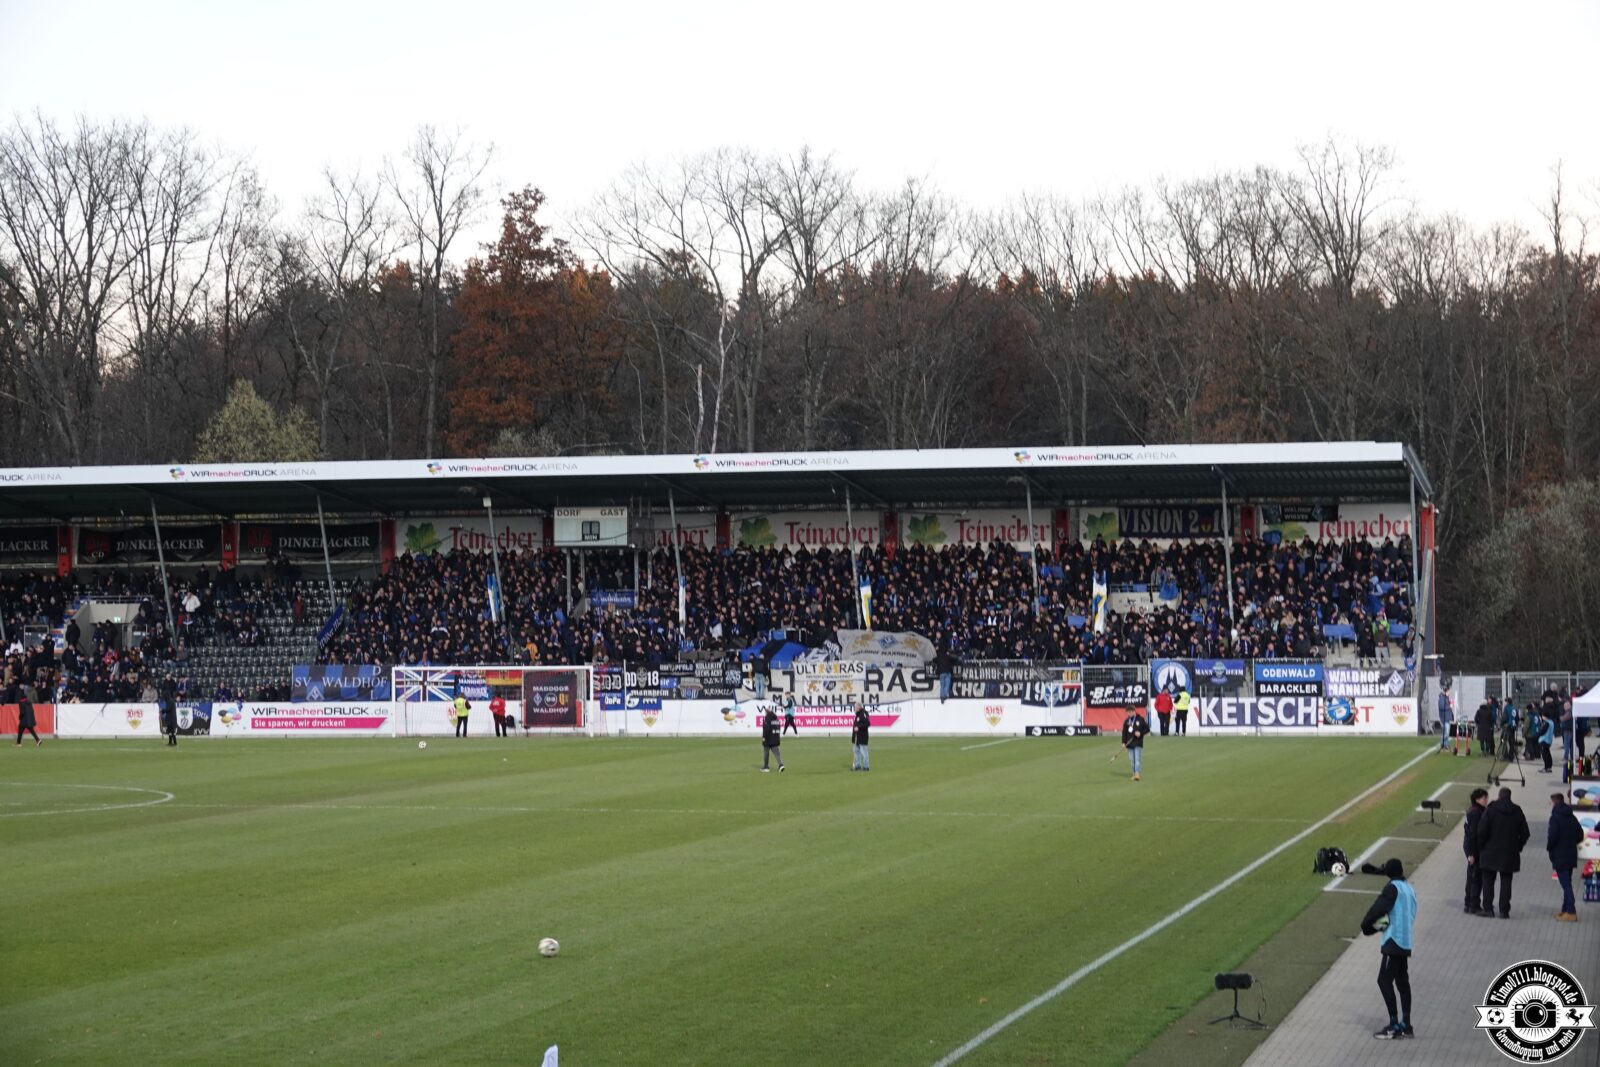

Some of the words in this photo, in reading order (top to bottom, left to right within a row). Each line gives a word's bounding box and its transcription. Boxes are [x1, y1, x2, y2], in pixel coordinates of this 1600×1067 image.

[1037, 453, 1134, 461] WIRmachenDRUCK
[1136, 452, 1177, 460] ARENA
[715, 458, 808, 467] WIRmachenDRUCK
[810, 457, 850, 465] ARENA
[190, 469, 278, 477] WIRmachenDRUCK
[279, 468, 316, 476] ARENA
[448, 464, 538, 472] WIRmachenDRUCK
[540, 463, 578, 471] ARENA
[26, 473, 62, 481] ARENA
[557, 509, 581, 517] DORF
[600, 509, 625, 517] GAST
[1120, 507, 1183, 533] VISION
[116, 539, 205, 551] DINKEACKER
[1262, 668, 1316, 678] ODENWALD
[1329, 670, 1380, 683] WALDHOF
[294, 676, 312, 688] SV
[322, 675, 388, 688] WALDHOF
[647, 671, 659, 686] 18
[1260, 683, 1318, 694] BARACKLER
[1329, 684, 1390, 697] MANNHEIM
[1200, 697, 1317, 725] KETSCH
[254, 719, 267, 727] Sie
[269, 719, 296, 729] sparen,
[298, 719, 310, 727] wir
[311, 719, 346, 727] drucken!
[806, 718, 820, 726] wir
